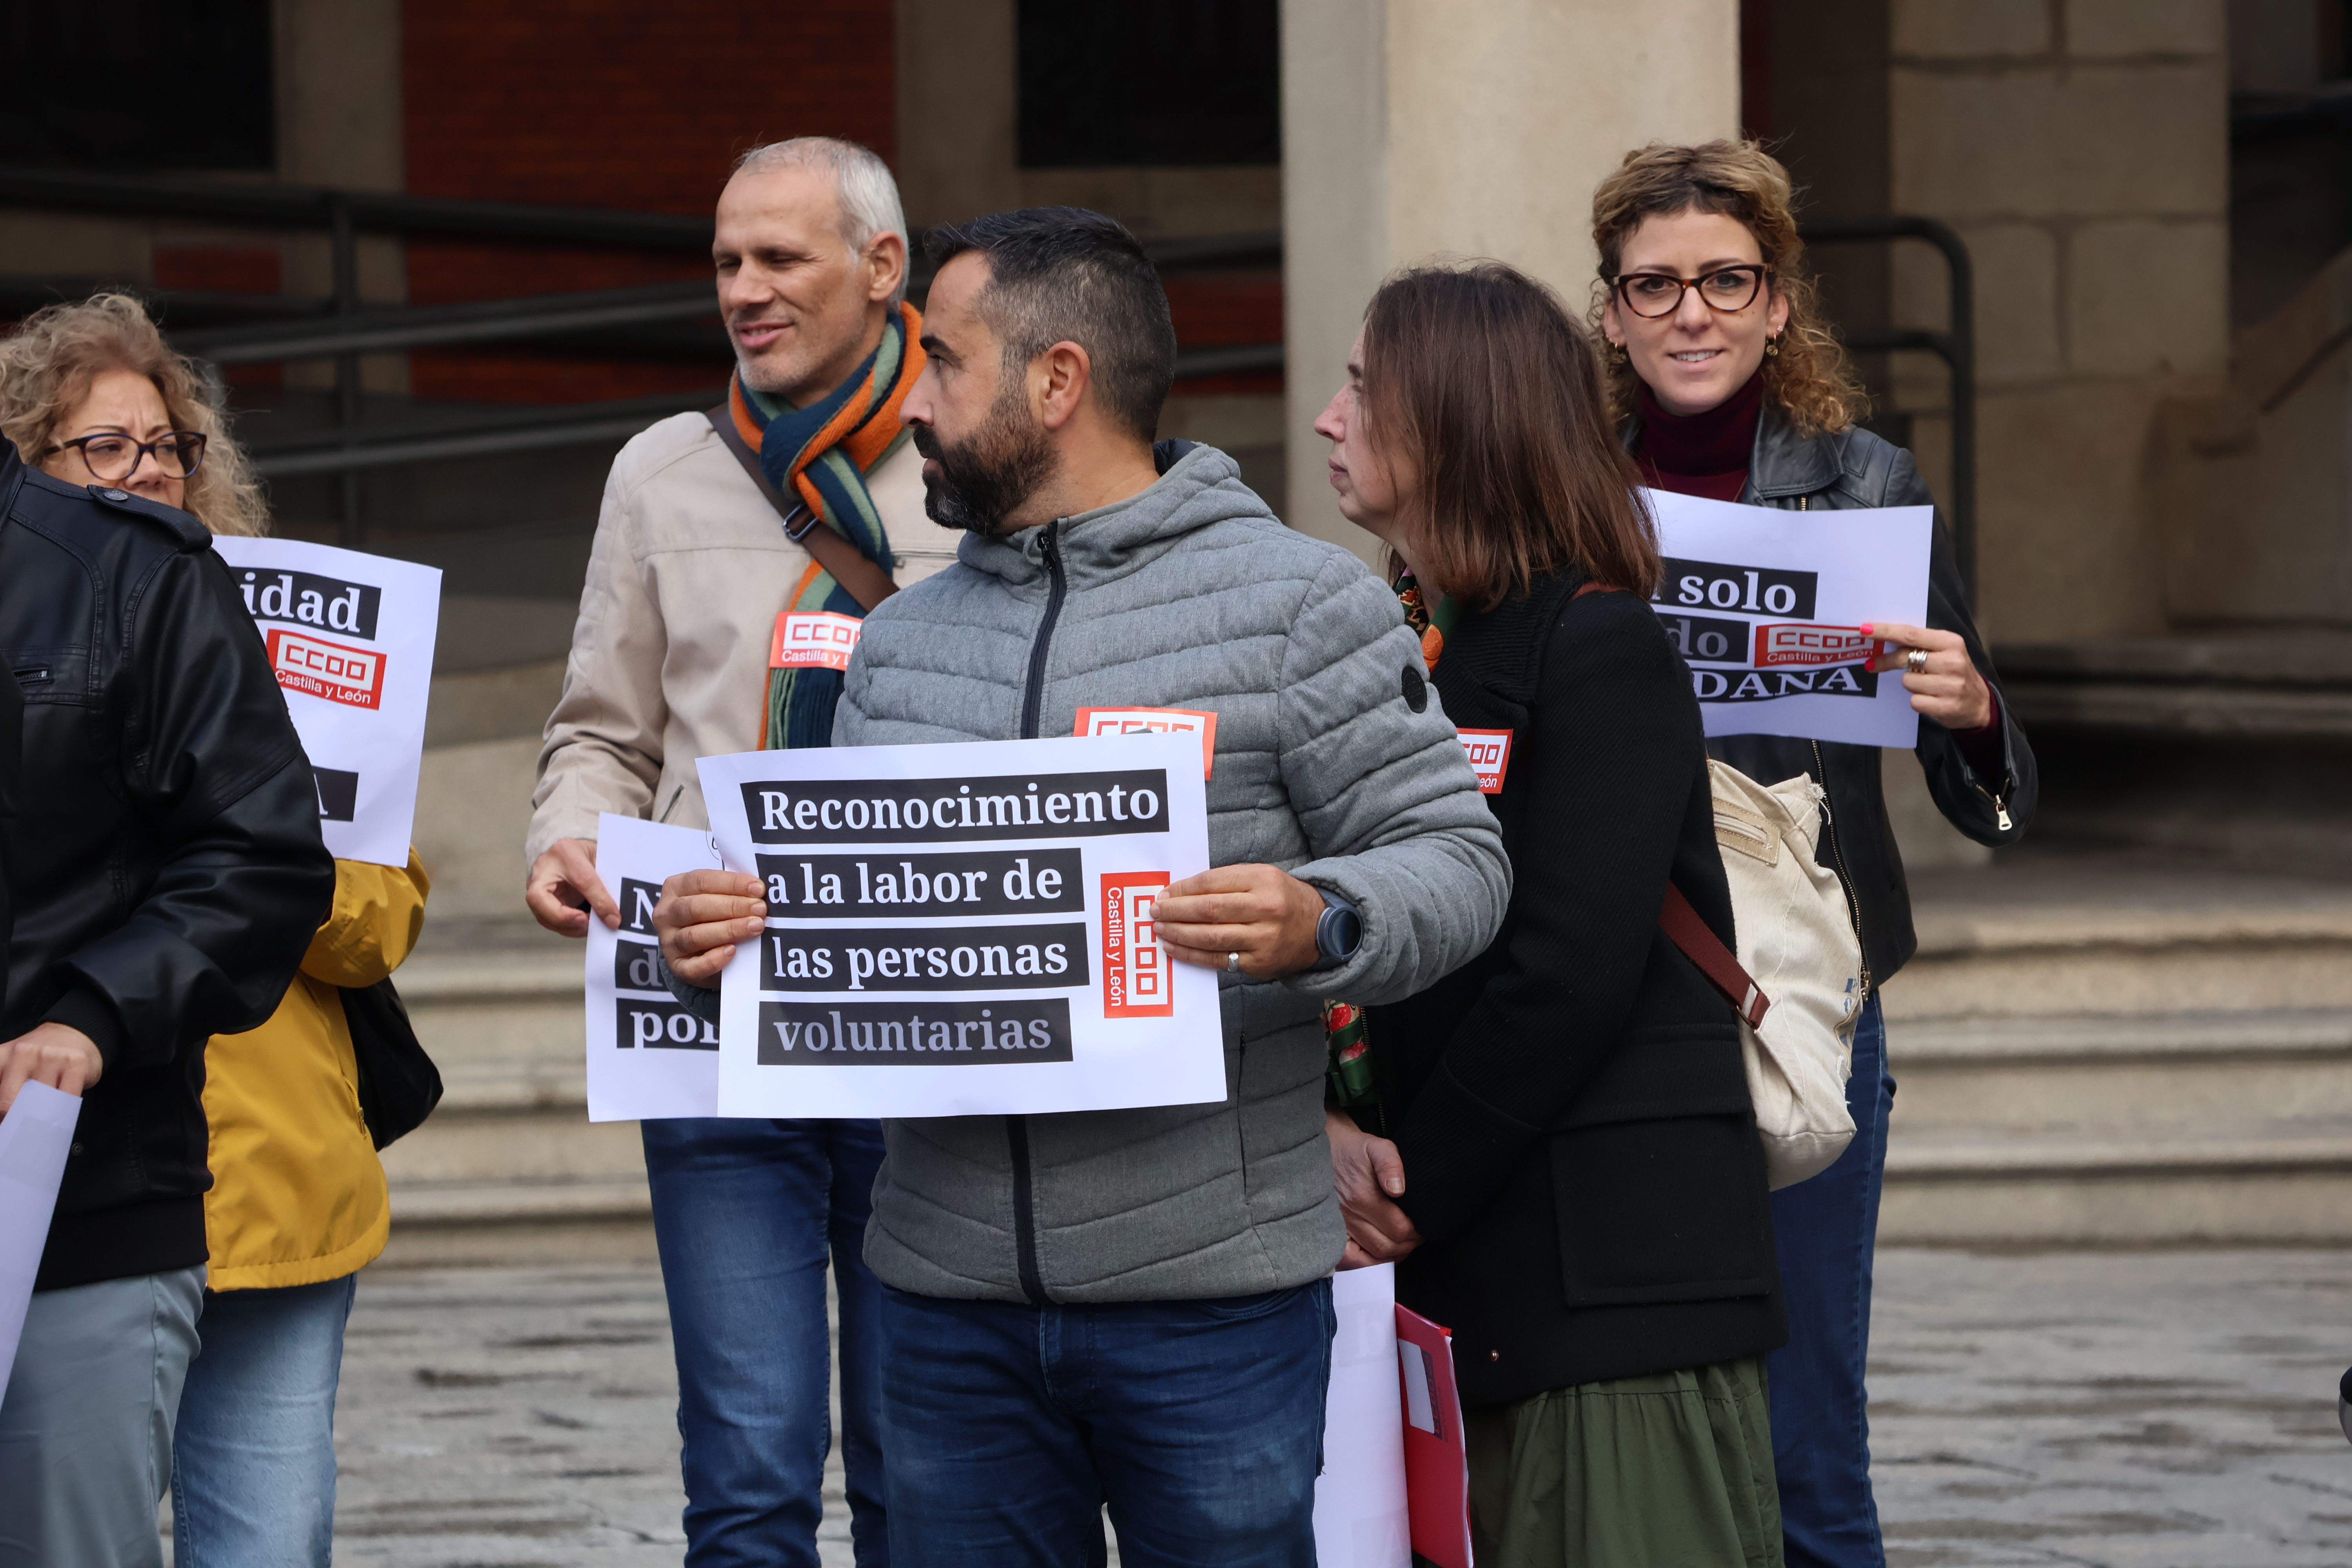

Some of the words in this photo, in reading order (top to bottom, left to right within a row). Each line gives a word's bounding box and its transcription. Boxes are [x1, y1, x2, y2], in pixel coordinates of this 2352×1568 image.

[240, 572, 360, 633] idad
[1678, 571, 1797, 613] solo
[782, 649, 828, 662] Castilla
[832, 653, 841, 666] y
[1767, 652, 1820, 662] Castilla
[1825, 654, 1833, 662] y
[1838, 649, 1873, 659] León
[1776, 632, 1866, 648] CCOO
[285, 644, 367, 681] CCOO
[1692, 667, 1862, 698] DANA
[275, 670, 322, 693] Castilla
[325, 685, 334, 698] y
[337, 686, 371, 704] León
[1480, 774, 1497, 788] eón
[759, 783, 1159, 830] Reconocimiento
[768, 873, 790, 904] a
[799, 862, 844, 904] la
[856, 862, 987, 904] labor
[1002, 858, 1062, 901] de
[1108, 887, 1123, 948] Castilla
[772, 936, 833, 978] las
[845, 942, 1069, 990] personas
[1106, 951, 1120, 962] y
[1134, 895, 1158, 995] CCOO
[1110, 966, 1125, 1007] León
[773, 1008, 1052, 1052] voluntarias
